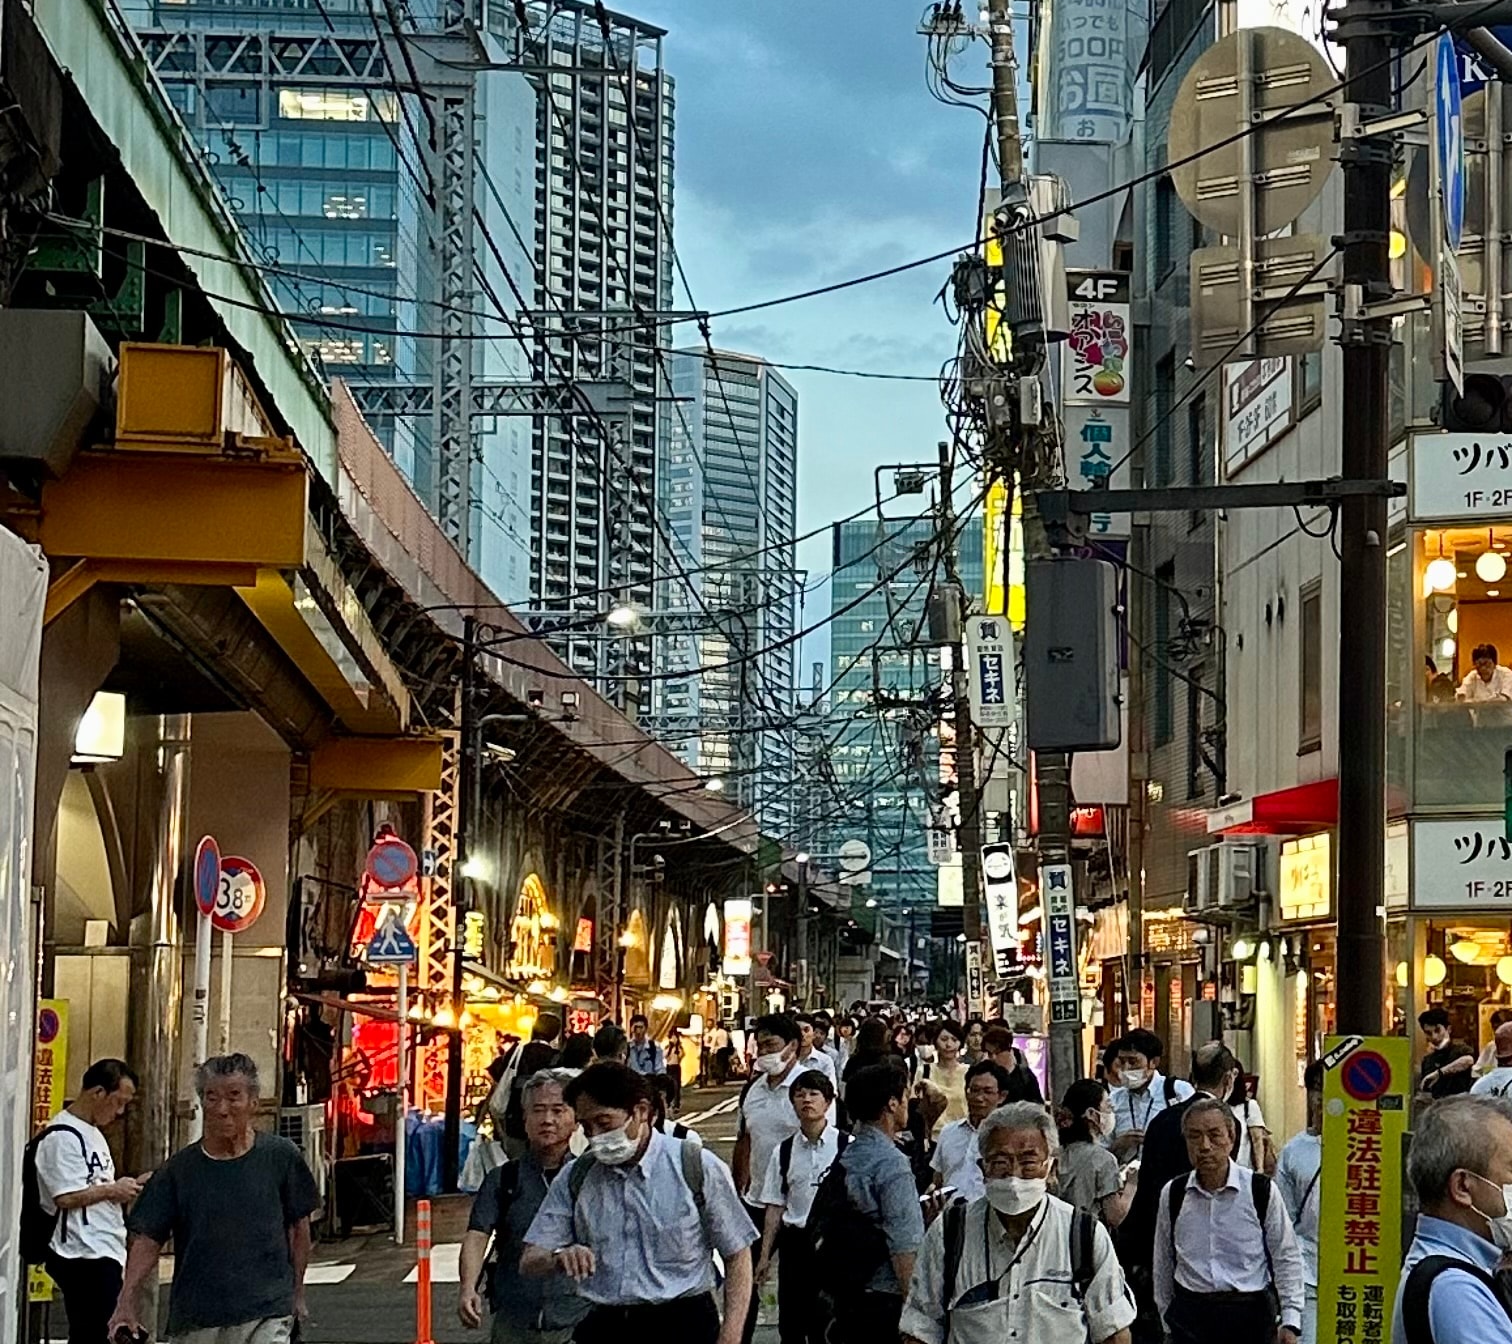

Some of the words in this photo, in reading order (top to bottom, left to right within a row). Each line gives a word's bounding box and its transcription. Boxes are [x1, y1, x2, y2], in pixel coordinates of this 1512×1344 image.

[1074, 277, 1119, 300] 4F
[982, 655, 1002, 704] セキネ
[1052, 916, 1071, 977] セキネ
[1343, 1107, 1383, 1276] 違法駐車禁止
